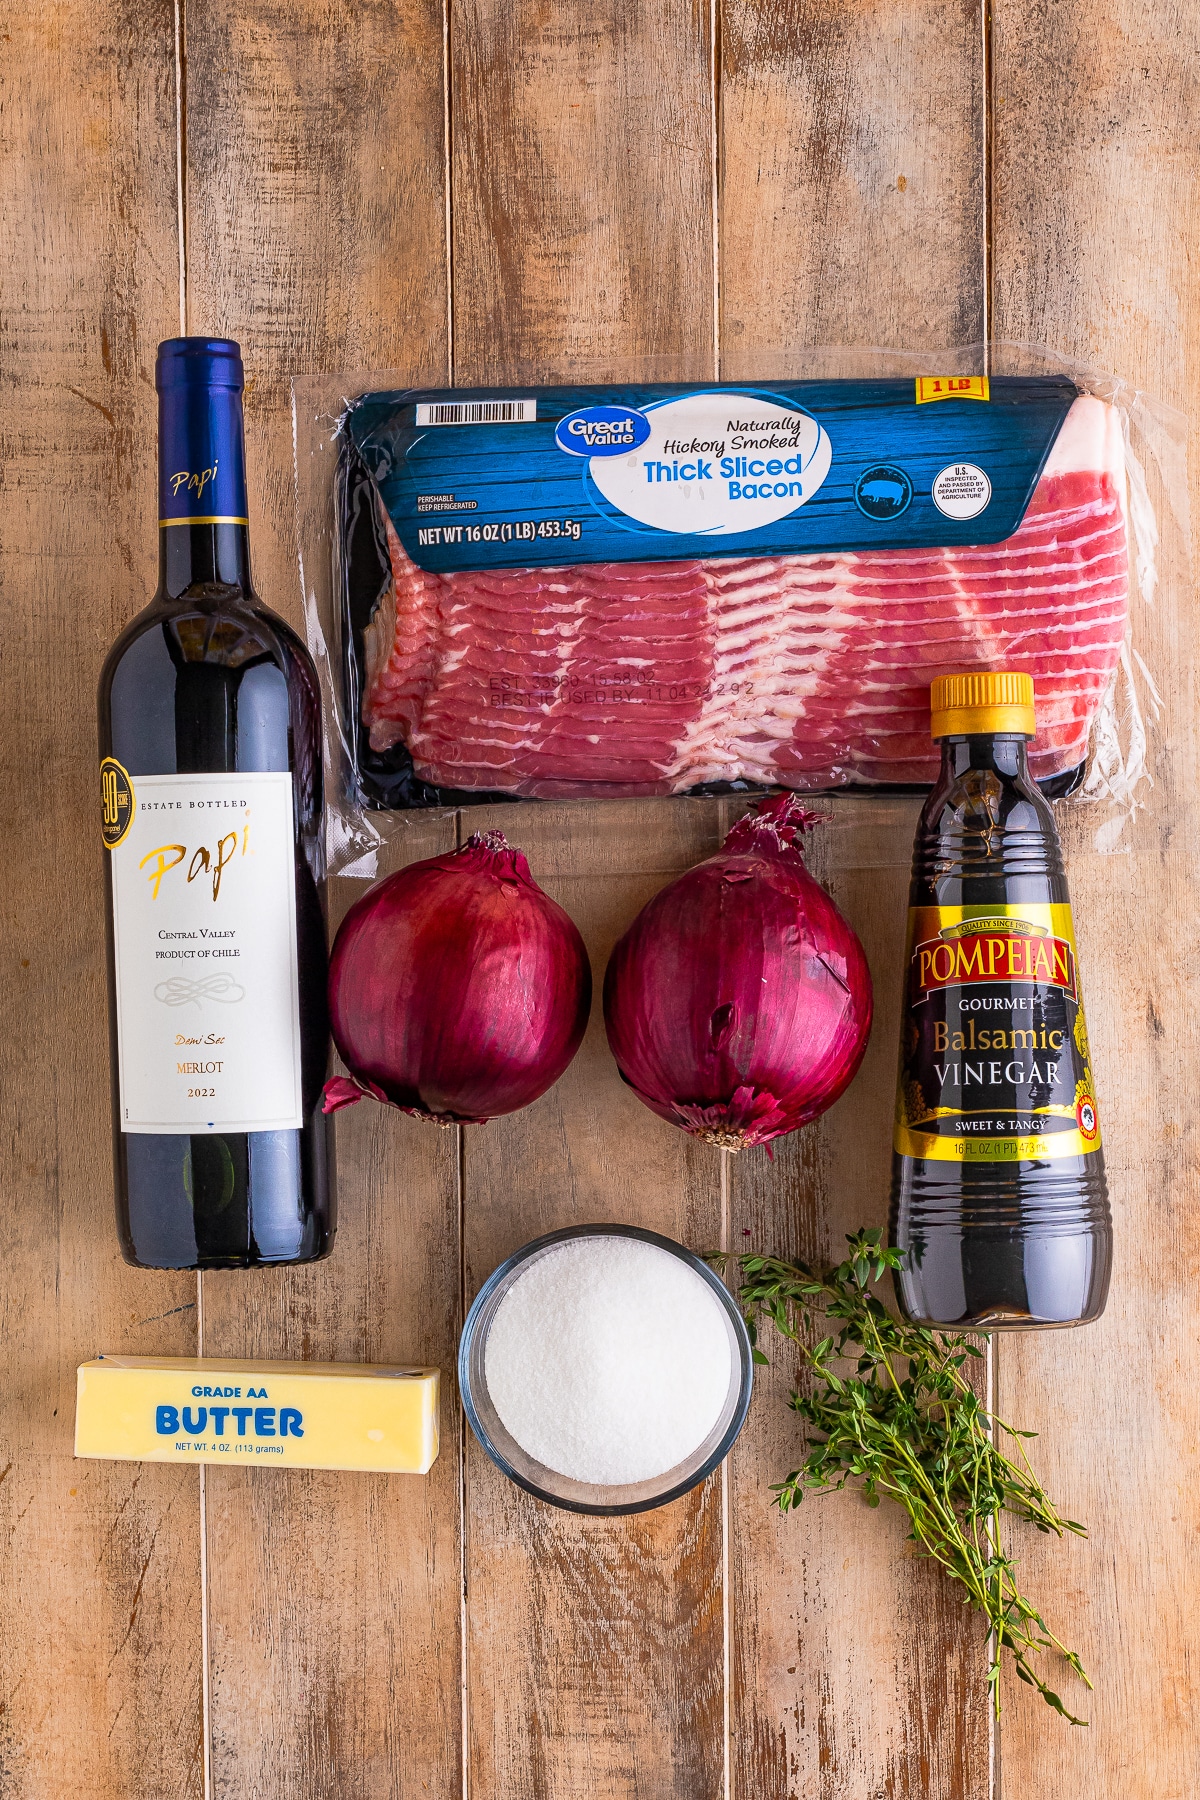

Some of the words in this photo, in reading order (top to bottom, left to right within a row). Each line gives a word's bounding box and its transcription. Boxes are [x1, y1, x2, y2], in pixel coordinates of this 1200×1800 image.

[933, 380, 943, 393] 1
[948, 379, 971, 392] LB
[567, 418, 634, 435] Great
[727, 416, 801, 434] Naturally
[583, 433, 634, 446] Value
[664, 437, 726, 458] Hickory
[731, 432, 800, 450] Smoked
[644, 458, 713, 483] Thick
[720, 454, 802, 478] Sliced
[955, 466, 969, 476] U.S.
[169, 459, 219, 499] Papi
[729, 481, 803, 500] Bacon
[937, 487, 976, 495] DEPARTMENT
[417, 494, 454, 504] PERISHABLE
[417, 503, 432, 512] KEEP
[433, 501, 477, 511] REFRIGERATED
[418, 528, 441, 546] NET
[443, 526, 463, 544] WT
[465, 526, 481, 542] 16
[483, 524, 499, 541] OZ
[501, 523, 512, 543] (1
[515, 522, 536, 541] LB)
[537, 520, 581, 540] 453.5g
[491, 692, 534, 707] BEST
[561, 690, 606, 704] USED
[102, 770, 119, 824] 90
[141, 801, 182, 811] ESTATE
[189, 800, 248, 809] BOTTLED
[139, 809, 251, 902] Papi
[961, 920, 992, 932] QUALITY
[992, 920, 1014, 928] SINCE
[155, 950, 195, 959] PRODUCT
[197, 949, 210, 958] OF
[212, 949, 241, 957] CHILE
[919, 937, 1070, 988] POMPEIAN
[958, 998, 1037, 1011] GOURMET
[174, 1033, 203, 1046] Demi
[204, 1033, 226, 1045] Sec
[933, 1018, 1063, 1052] Balsamic
[176, 1061, 224, 1074] MERLOT
[933, 1060, 1063, 1087] VINEGAR
[187, 1088, 216, 1097] 2022
[955, 1120, 993, 1131] SWEET
[996, 1120, 1006, 1130] &
[1008, 1119, 1046, 1130] TANGY
[954, 1143, 964, 1154] 16
[994, 1143, 1000, 1154] (1
[1003, 1142, 1018, 1154] PT)
[1019, 1142, 1035, 1153] 473
[191, 1385, 241, 1398] GRADE
[246, 1387, 268, 1399] AA
[155, 1405, 305, 1438] BUTTER
[175, 1442, 191, 1451] NET
[193, 1443, 209, 1452] WT.
[211, 1443, 216, 1452] 4
[218, 1443, 232, 1452] OZ.
[235, 1443, 253, 1454] (113
[255, 1445, 284, 1455] grams)
